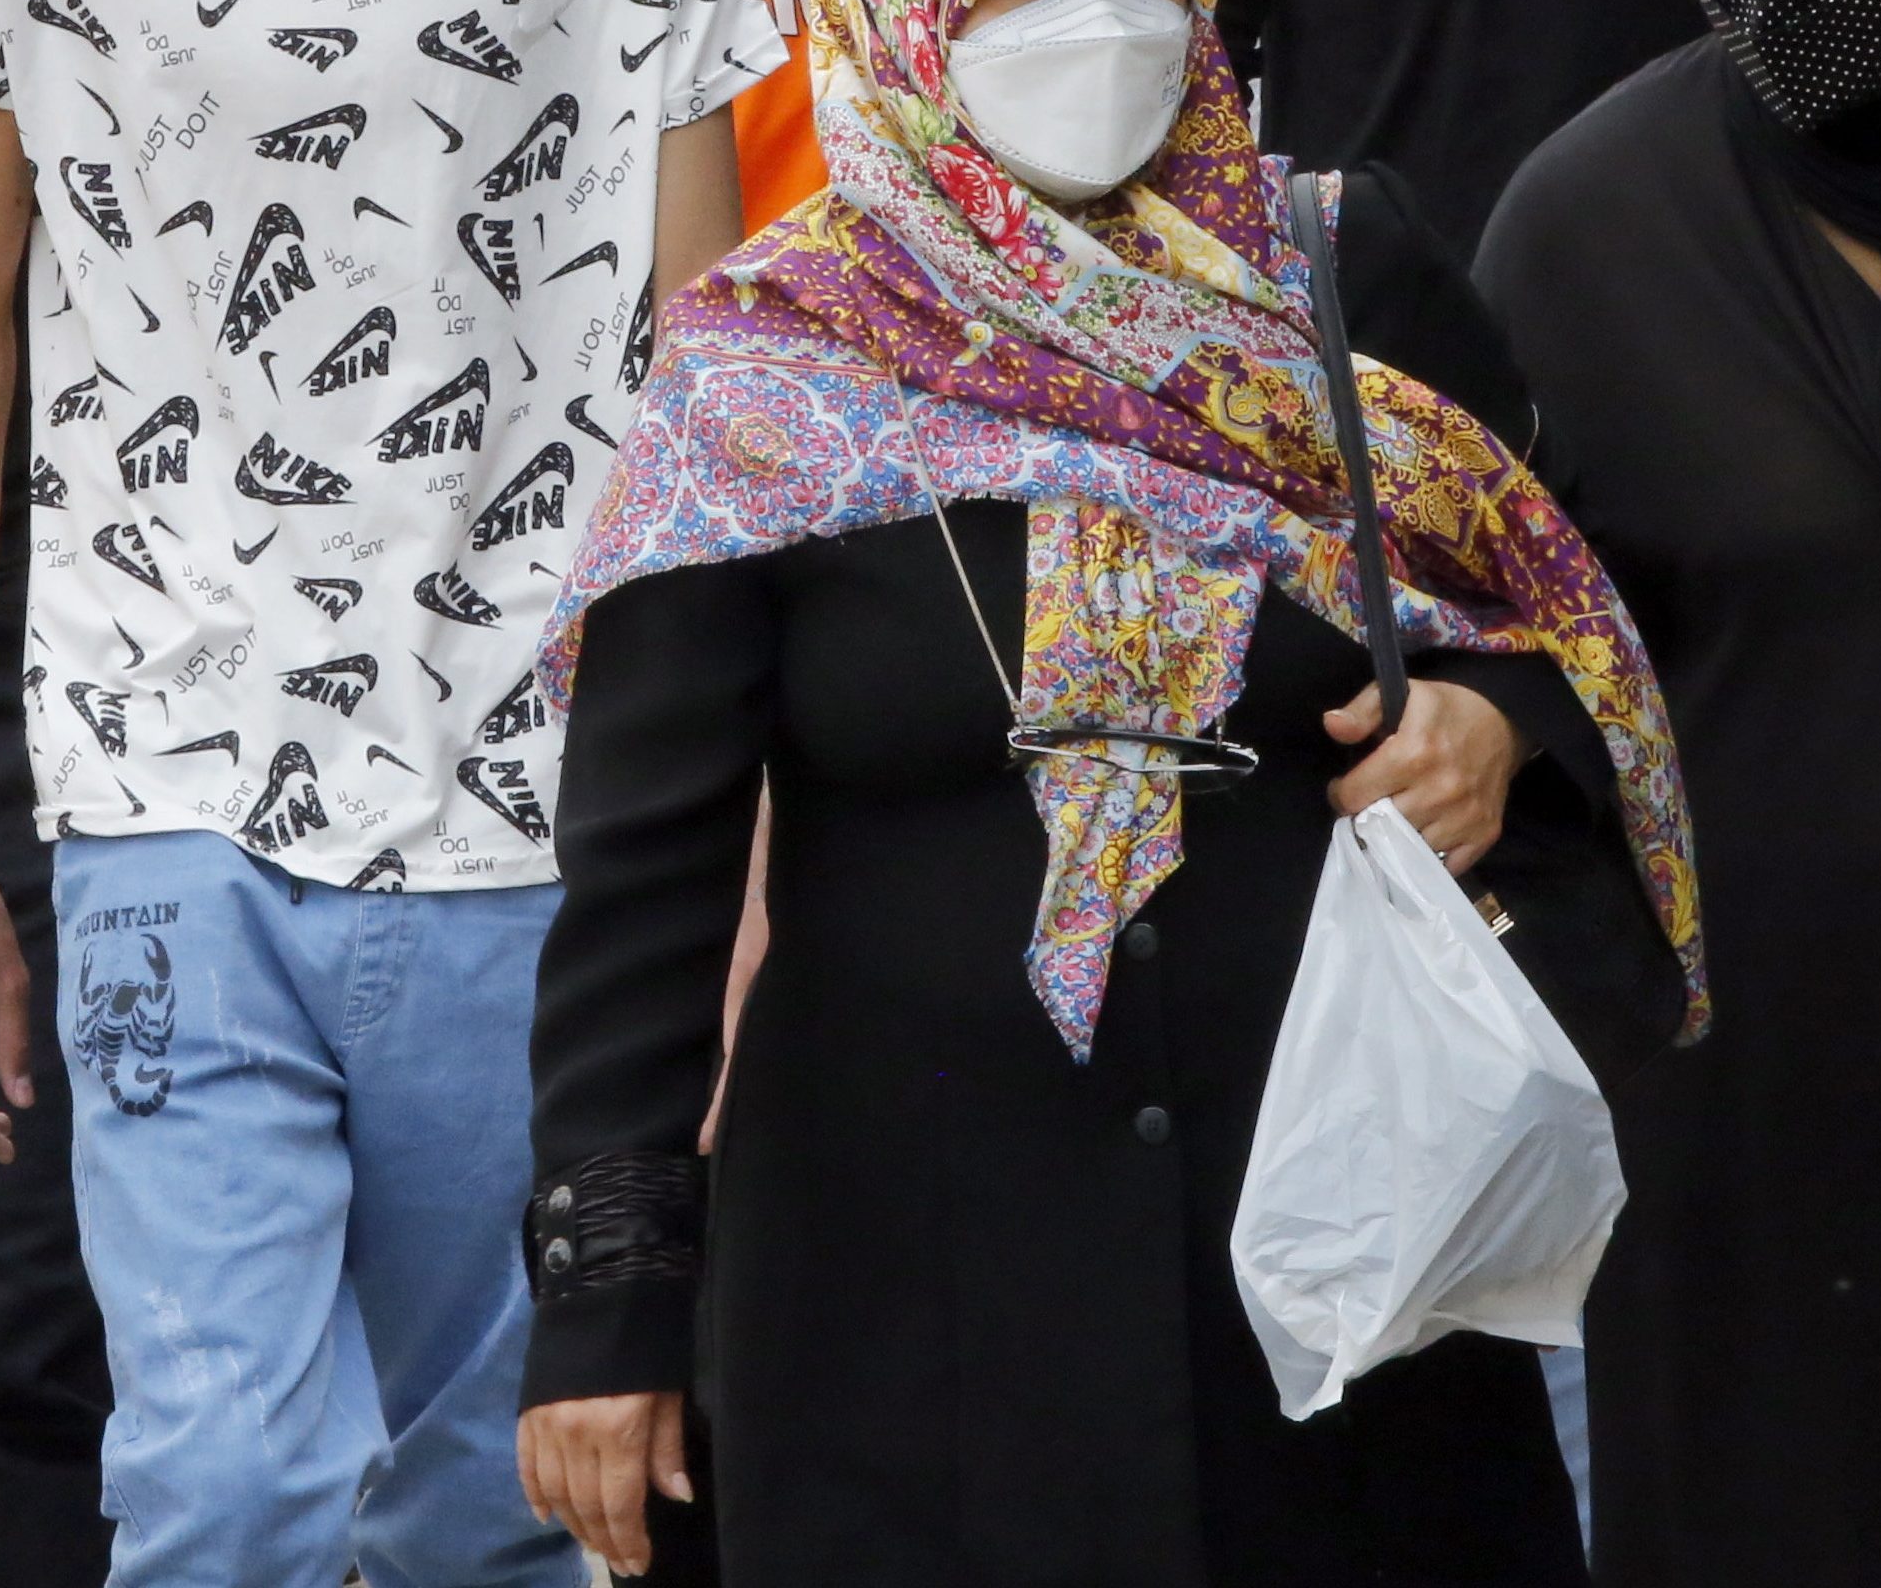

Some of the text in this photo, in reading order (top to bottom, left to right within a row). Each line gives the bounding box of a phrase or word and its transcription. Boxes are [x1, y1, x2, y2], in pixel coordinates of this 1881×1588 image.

[146, 35, 169, 51] DO
[160, 48, 197, 68] JUST
[267, 32, 340, 73] NIKE
[447, 10, 522, 78] NIKE
[176, 90, 220, 150] DO IT
[143, 114, 172, 171] JUST
[255, 134, 350, 171] NIKE
[483, 135, 568, 202] NIKE
[603, 166, 626, 196] DO
[78, 164, 132, 248] NIKE
[565, 165, 606, 215] JUST
[205, 251, 233, 304] JUST
[333, 256, 354, 274] DO
[345, 264, 377, 289] JUST
[483, 220, 520, 300] NIKE
[226, 245, 316, 356] NIKE
[438, 295, 461, 312] DO
[608, 293, 630, 345] JUST
[444, 316, 476, 336] JUST
[582, 318, 606, 350] DO
[310, 341, 389, 396] NIKE
[378, 403, 485, 463] NIKE
[249, 431, 352, 499] NIKE
[425, 473, 465, 493] JUST
[472, 485, 565, 551] NIKE
[37, 539, 60, 552] DO
[333, 532, 354, 549] DO
[350, 539, 385, 562] JUST
[190, 576, 211, 591] DO
[205, 584, 233, 605] JUST
[172, 645, 217, 694] JUST
[216, 645, 248, 680] DO
[281, 675, 365, 718] NIKE
[97, 691, 131, 758] NIKE
[484, 695, 546, 744] IKE
[54, 744, 83, 794] JUST
[220, 780, 254, 822] JUST
[358, 809, 389, 830] JUST
[489, 760, 551, 839] NIKE
[440, 837, 469, 853] DO
[453, 856, 498, 875] JUST
